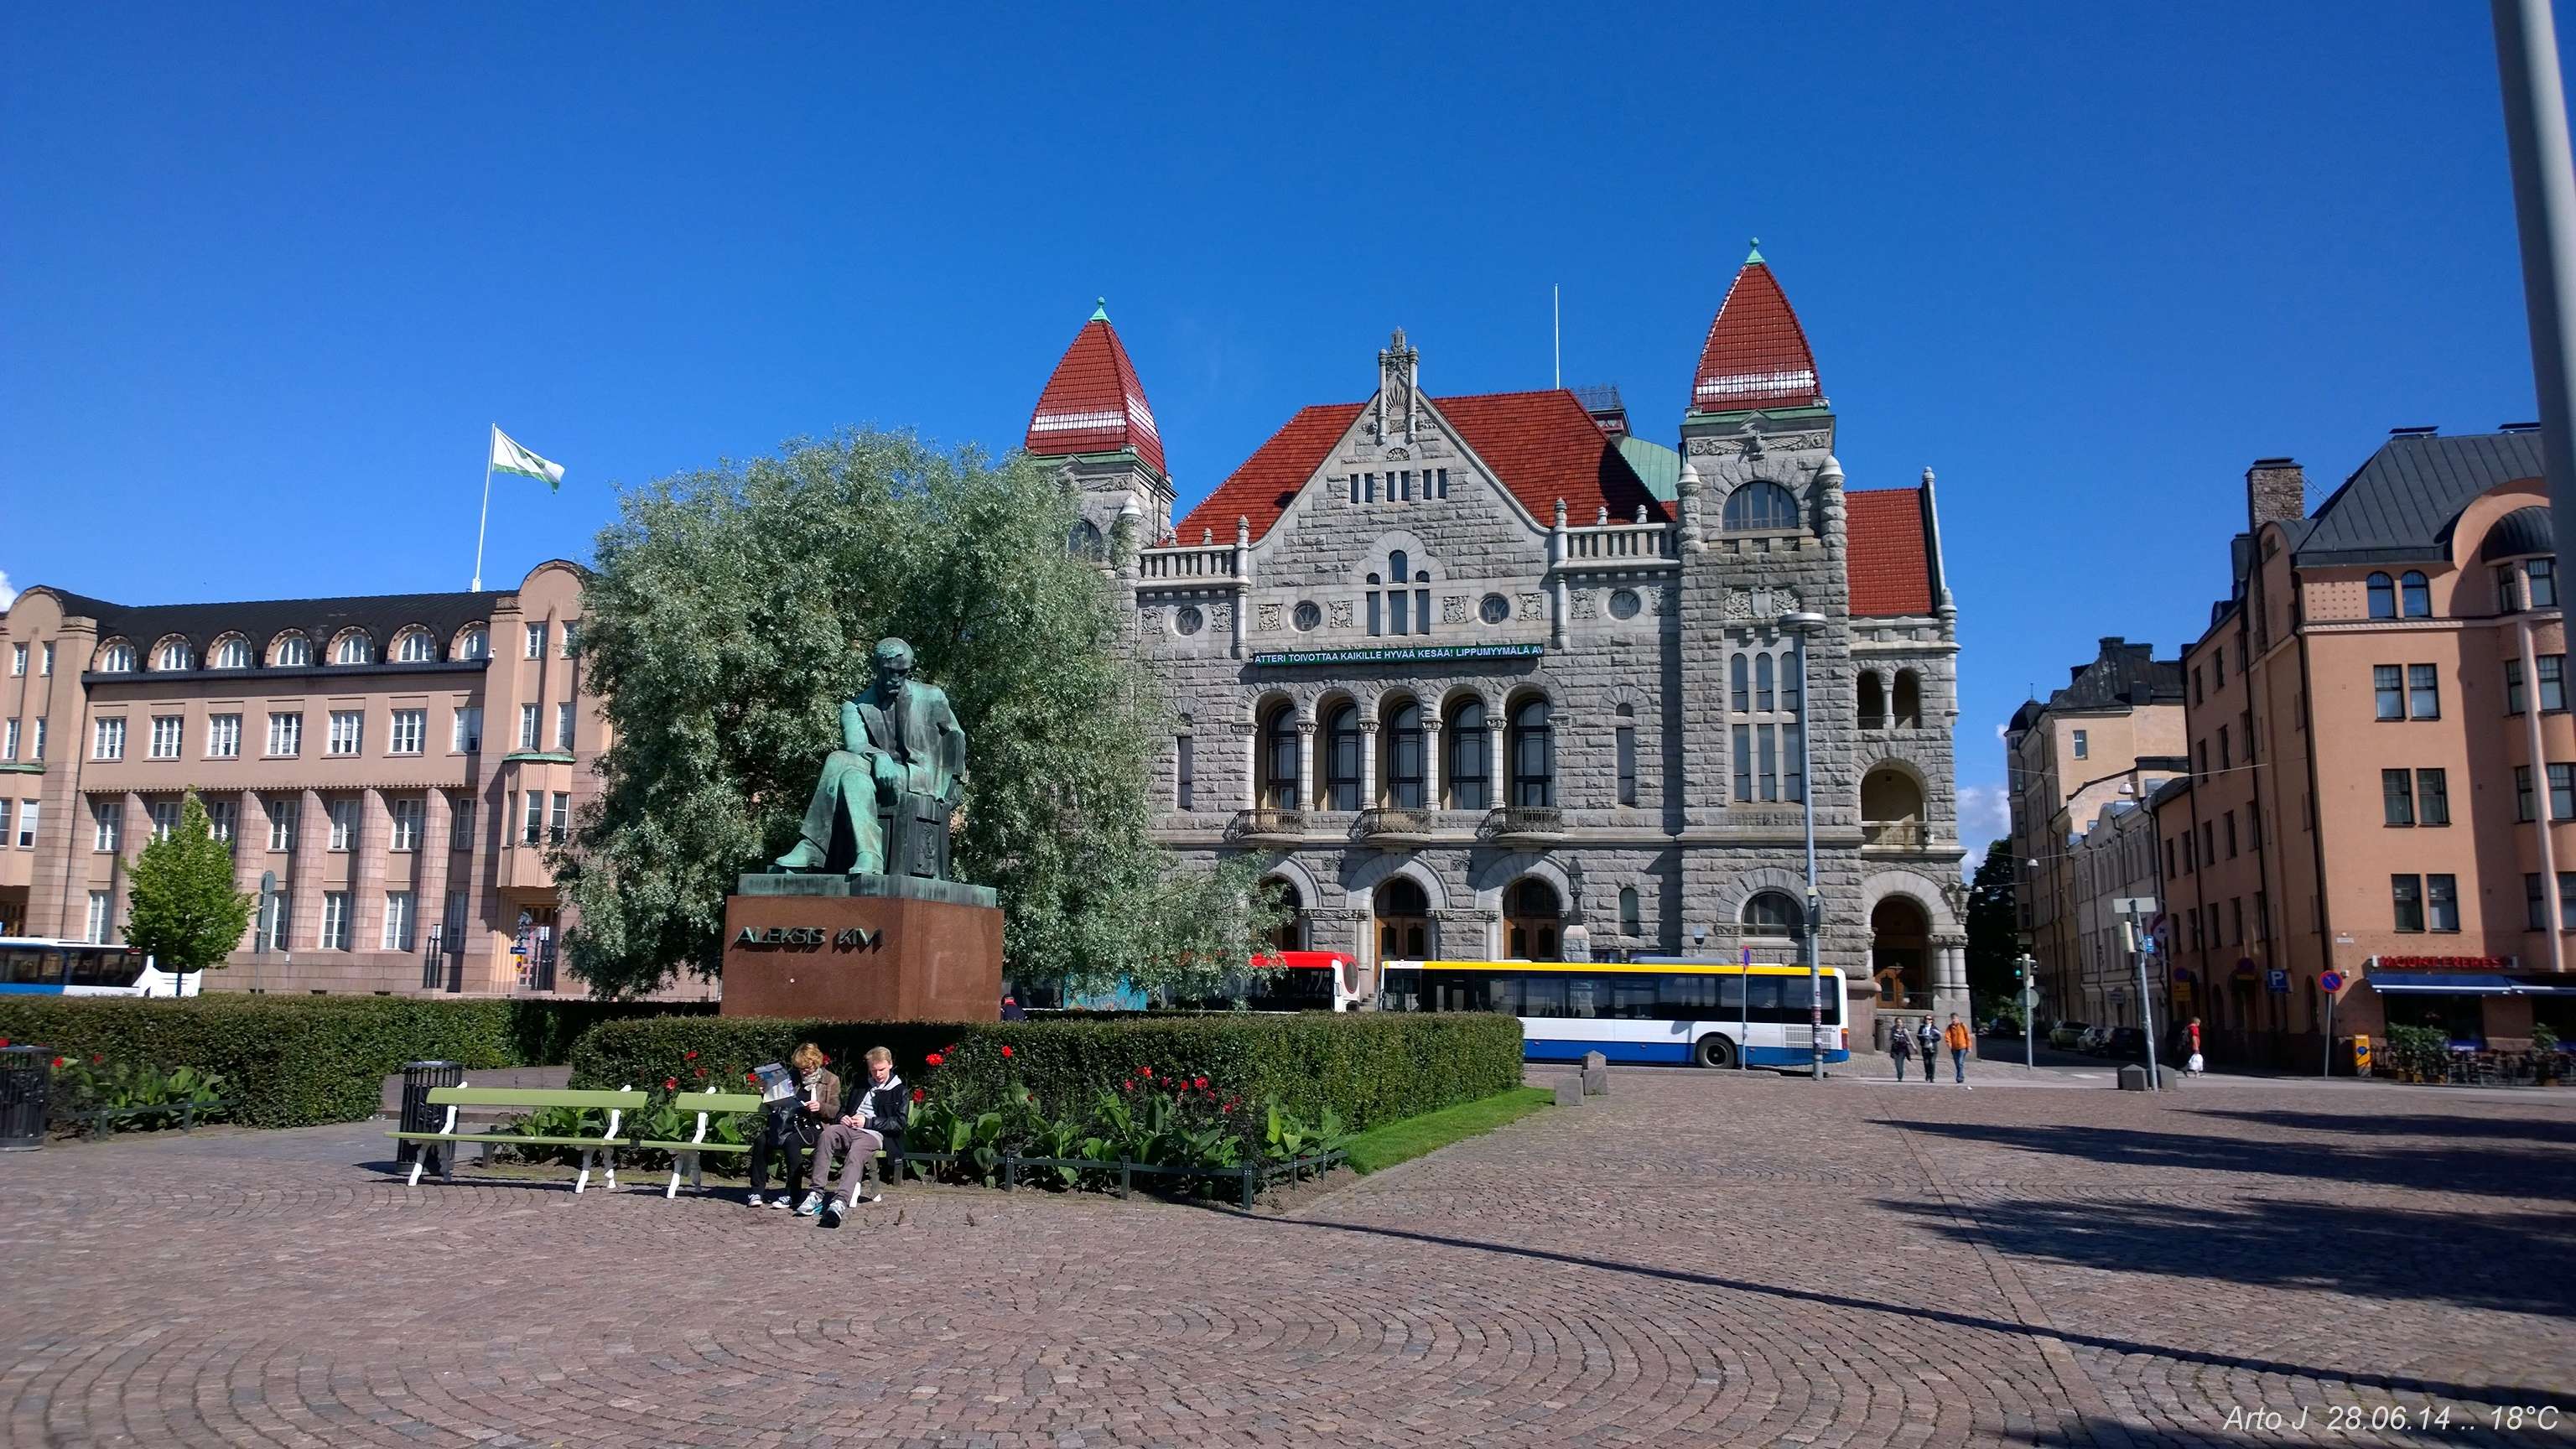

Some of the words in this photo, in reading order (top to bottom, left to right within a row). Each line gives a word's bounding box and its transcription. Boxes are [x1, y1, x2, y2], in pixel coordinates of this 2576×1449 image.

[1288, 652, 1338, 662] TOIVOTTAA
[1340, 651, 1382, 661] KAIKILLE
[1384, 649, 1415, 659] HYVÄÄ
[1418, 648, 1452, 658] KESÄÄ!
[1456, 646, 1530, 657] LIPPUMYYMÄLÄ
[735, 927, 826, 945] ALEKSIS
[2271, 971, 2283, 985] P
